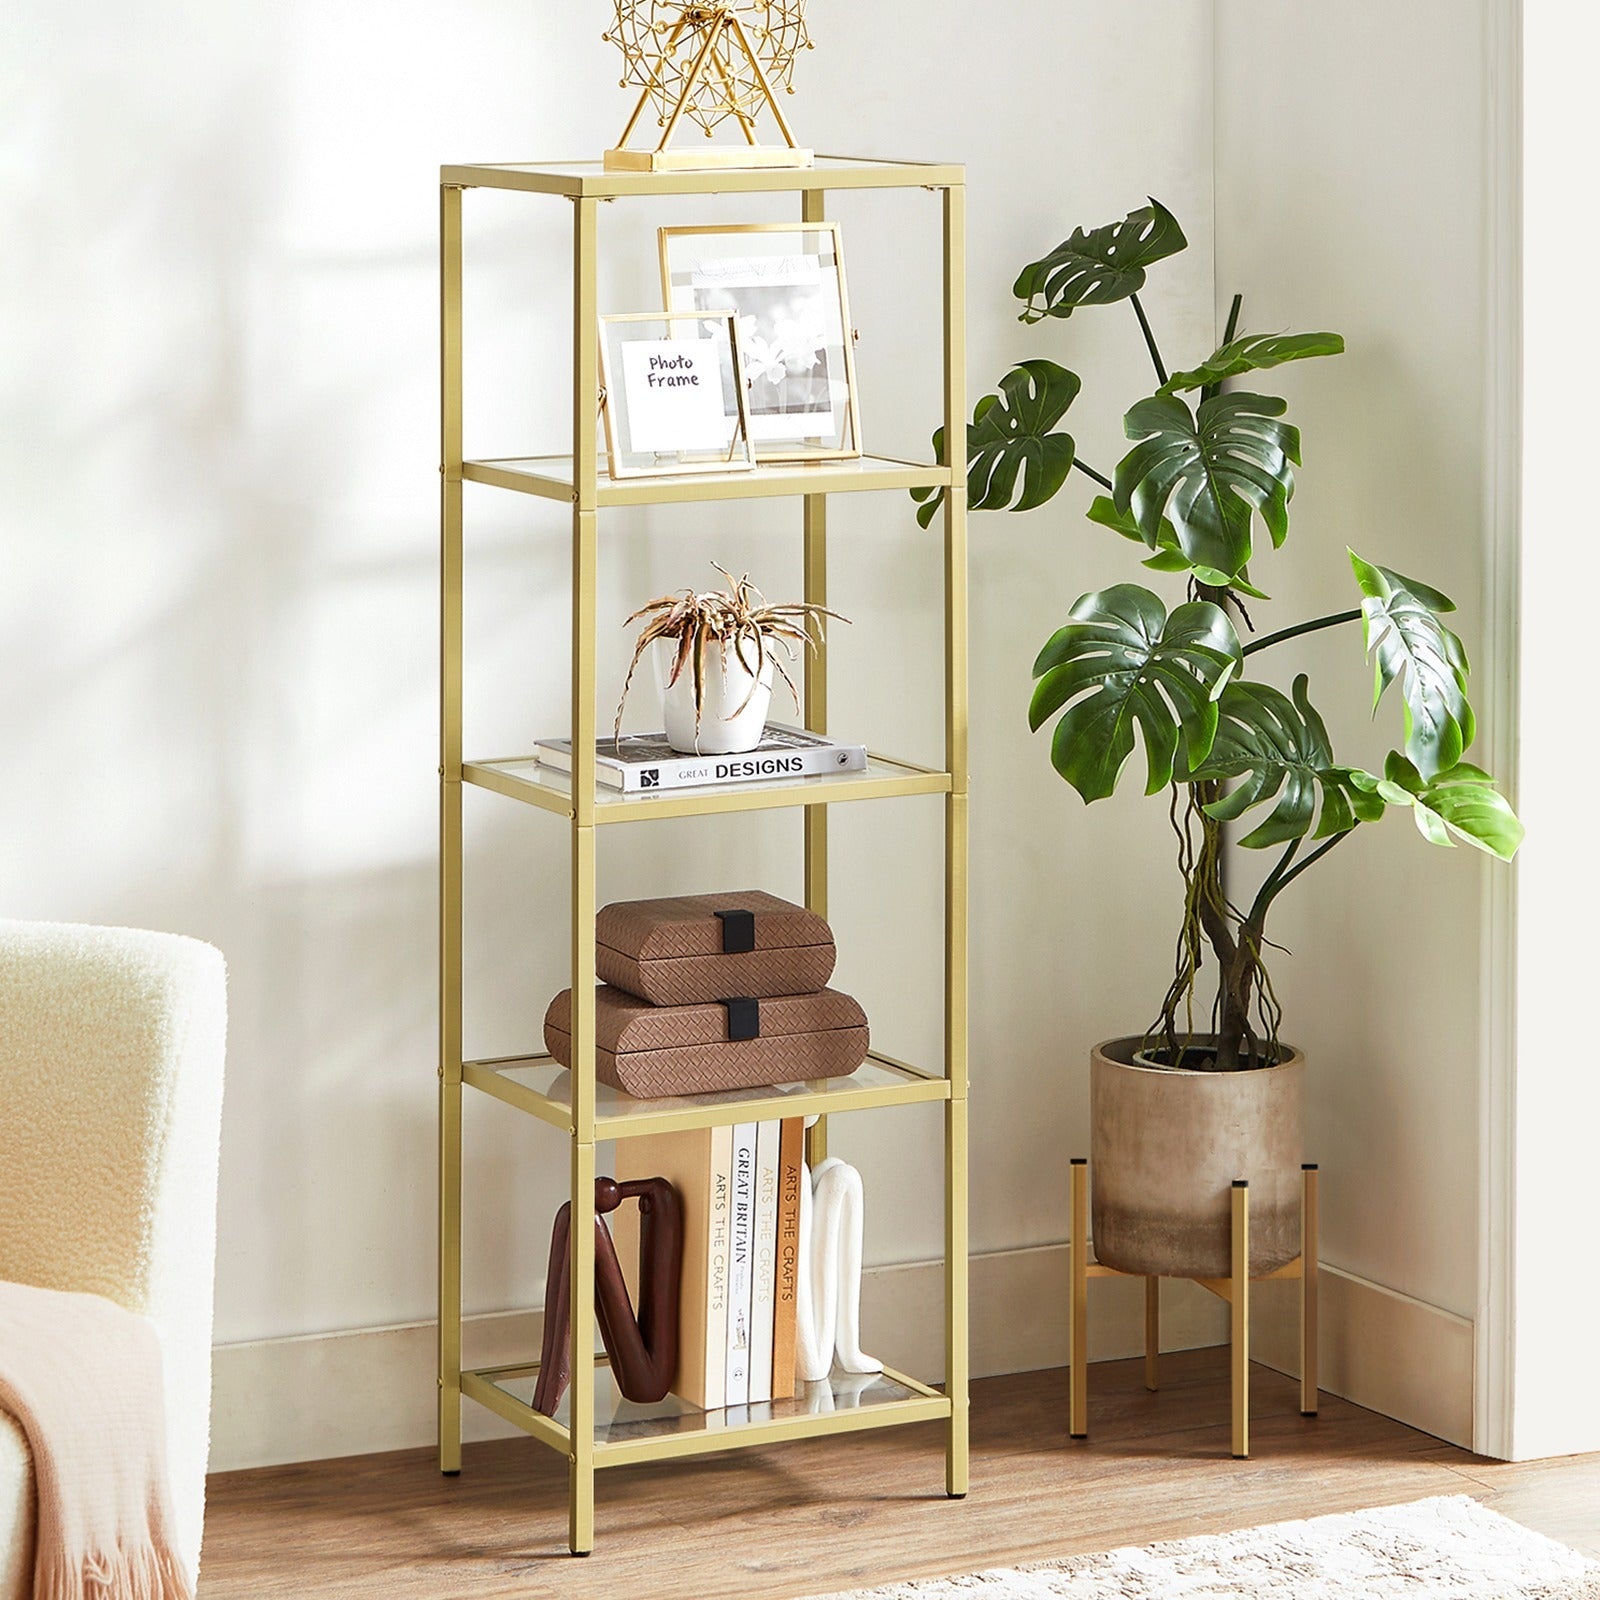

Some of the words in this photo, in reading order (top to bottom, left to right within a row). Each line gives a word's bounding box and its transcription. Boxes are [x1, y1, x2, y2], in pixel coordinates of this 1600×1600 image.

[647, 373, 699, 387] Frame
[649, 354, 693, 370] Photo
[678, 769, 708, 779] GREAT
[715, 757, 803, 779] DESIGNS
[737, 1147, 750, 1200] GREAT
[762, 1167, 773, 1204] ARTS
[785, 1165, 797, 1202] ARTS
[716, 1174, 726, 1210] ARTS
[713, 1218, 725, 1247] THE
[735, 1202, 749, 1263] BRITAIN
[759, 1210, 772, 1240] THE
[783, 1209, 796, 1239] THE
[712, 1254, 724, 1310] CRAFTS
[758, 1248, 771, 1302] CRAFTS
[781, 1246, 795, 1301] CRAFTS
